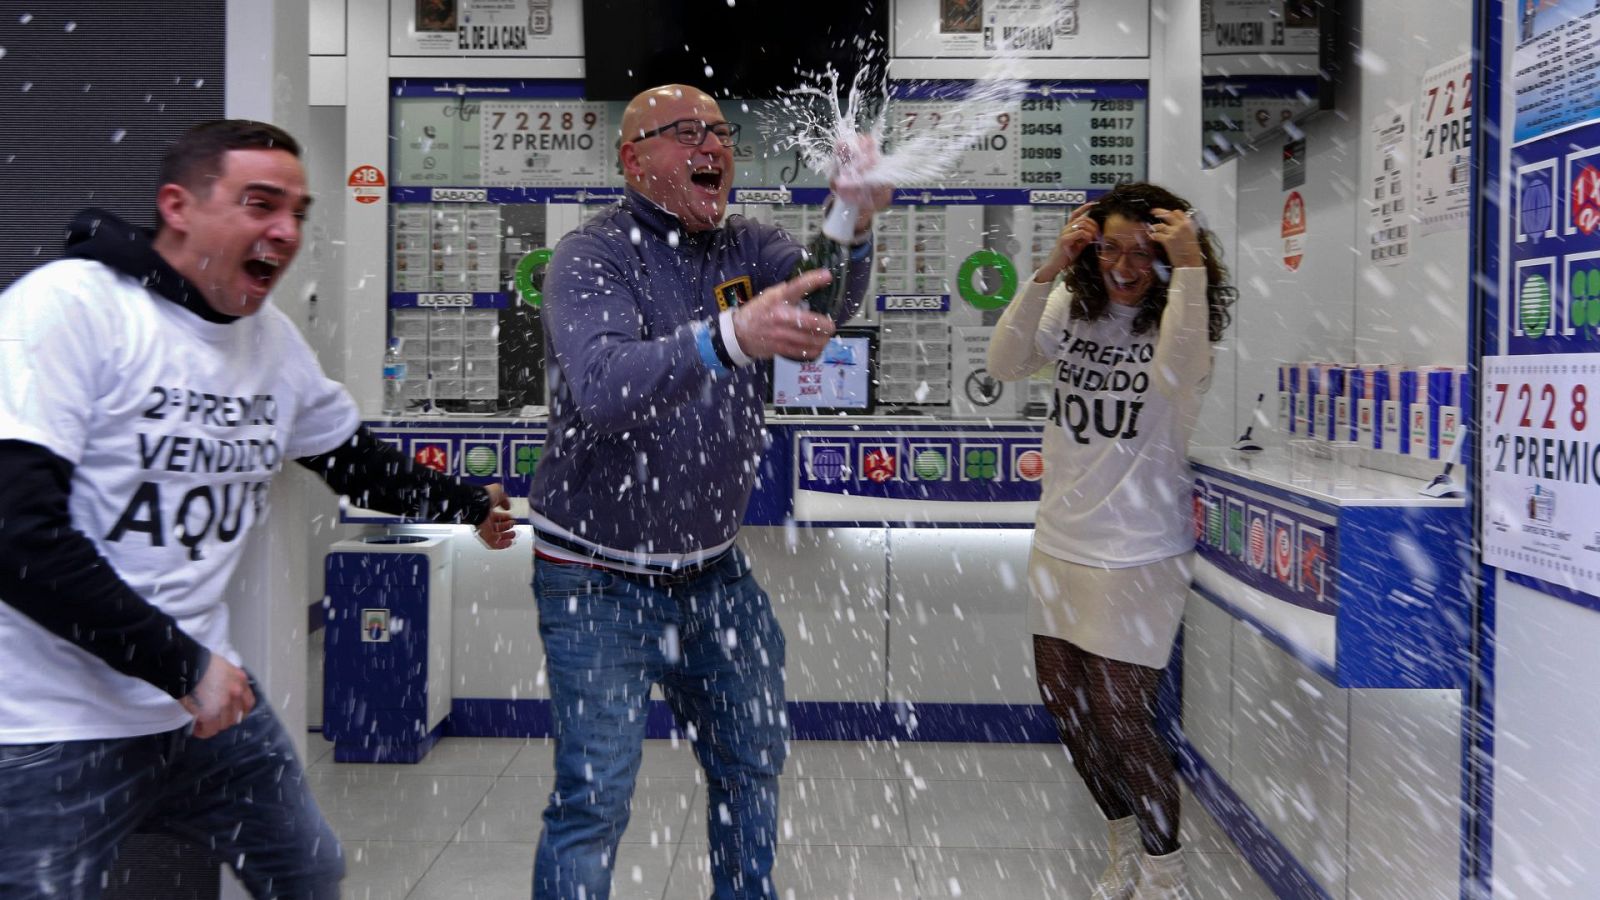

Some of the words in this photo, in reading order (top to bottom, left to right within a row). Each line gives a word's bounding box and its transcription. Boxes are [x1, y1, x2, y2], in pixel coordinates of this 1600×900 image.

[459, 26, 470, 50] EL
[473, 26, 484, 50] DE
[488, 26, 499, 50] LA
[502, 26, 528, 50] CASA
[512, 134, 593, 150] PREMIO
[434, 191, 485, 201] SABADO
[1032, 193, 1085, 202] SABADO
[420, 294, 472, 305] JUEVES
[888, 298, 939, 308] JUEVES
